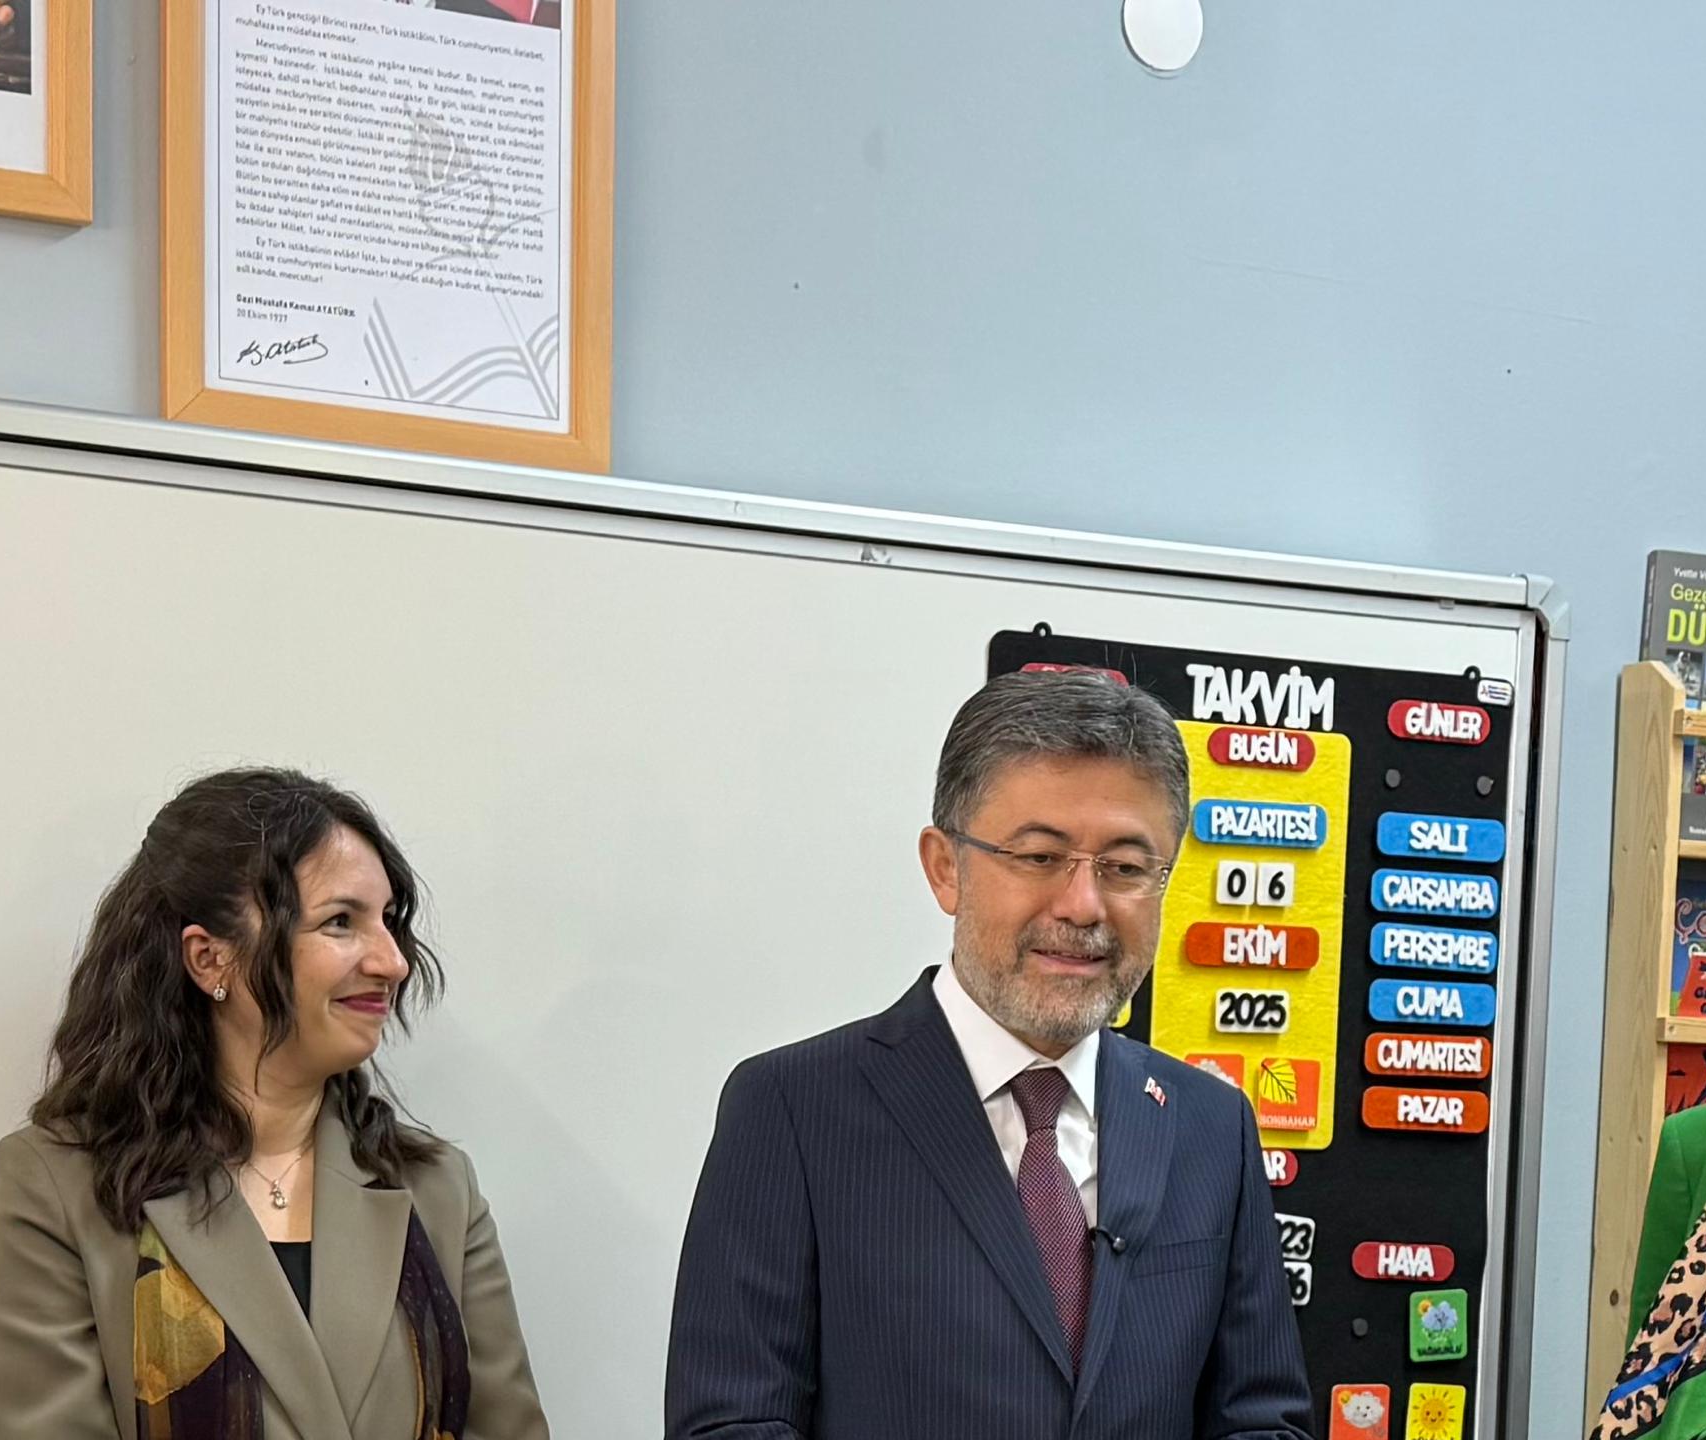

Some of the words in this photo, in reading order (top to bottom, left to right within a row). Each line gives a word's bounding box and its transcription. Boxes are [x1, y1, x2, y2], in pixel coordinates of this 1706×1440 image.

[1186, 663, 1335, 731] TAKVİM
[1405, 703, 1482, 740] GÜNLER
[1229, 731, 1298, 765] BUGÜN
[1211, 806, 1318, 841] PAZARTESİ
[1410, 821, 1468, 852] SALI
[1383, 875, 1494, 911] ÇARŞAMBA
[1223, 924, 1287, 965] EKİM
[1384, 928, 1492, 967] PERŞEMBE
[1219, 992, 1287, 1028] 2025
[1396, 986, 1463, 1019] CUMA
[1377, 1038, 1483, 1072] CUMARTESİ
[1260, 1114, 1316, 1127] SONBAHAR
[1397, 1095, 1463, 1125] PAZAR
[1377, 1244, 1435, 1279] HAVA
